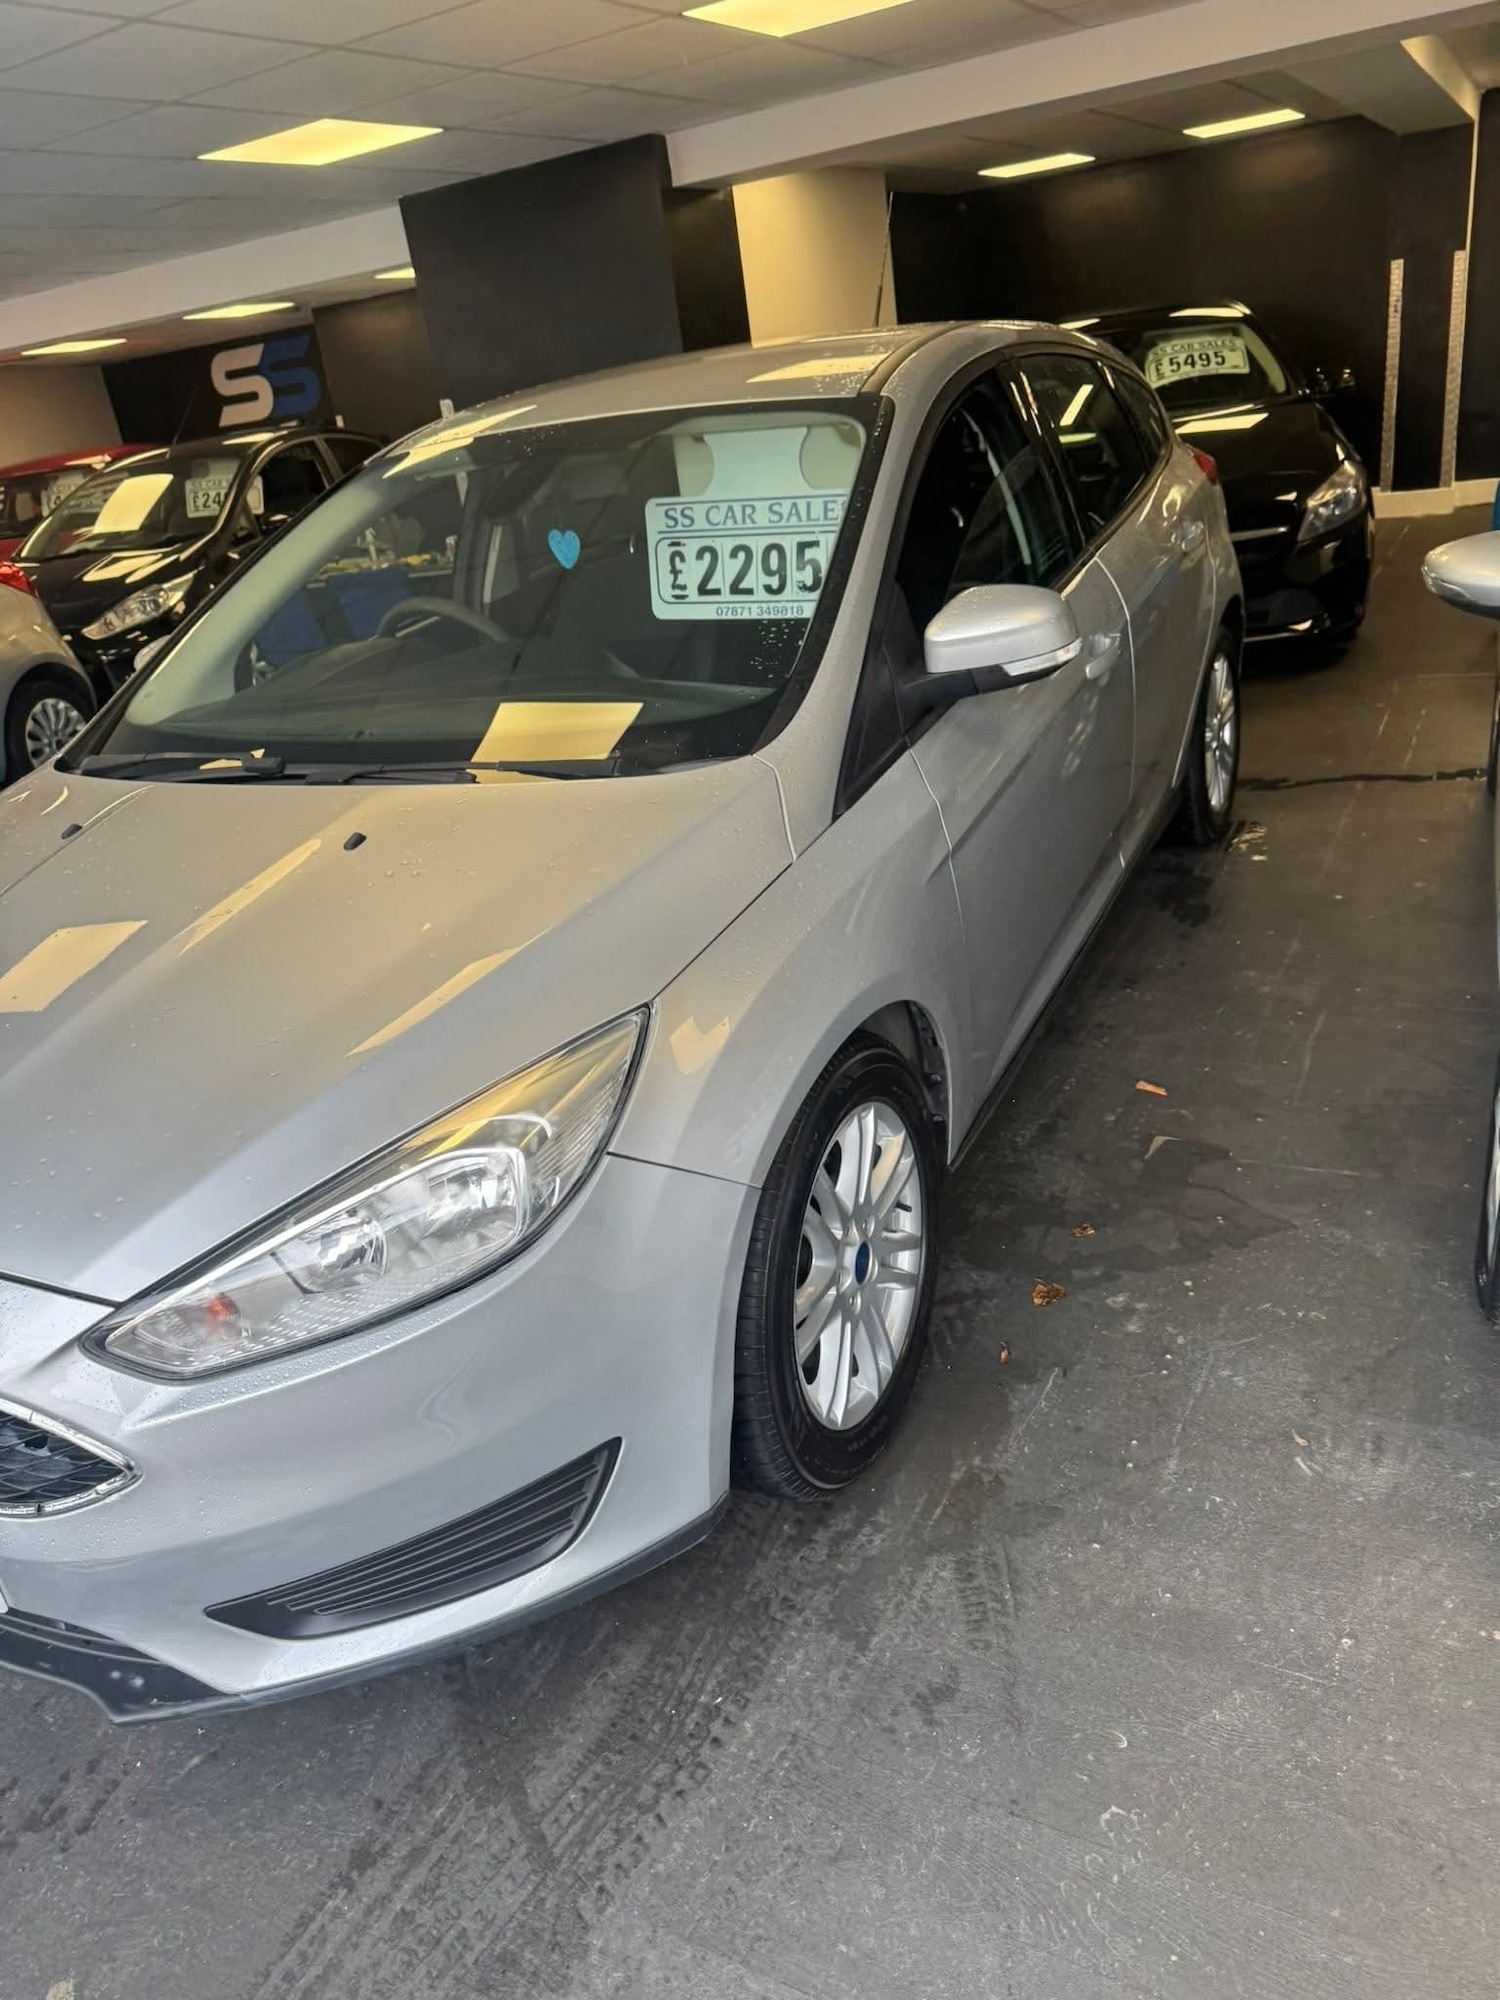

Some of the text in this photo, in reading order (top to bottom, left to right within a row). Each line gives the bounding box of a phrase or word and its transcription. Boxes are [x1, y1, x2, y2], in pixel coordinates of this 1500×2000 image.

[1171, 343, 1194, 354] CAR
[1200, 339, 1236, 350] SALES
[1155, 350, 1226, 377] £5495
[211, 336, 321, 427] SS
[664, 506, 695, 529] SS
[705, 504, 757, 526] CAR
[668, 540, 823, 599] £2295
[715, 605, 804, 617] 07871 349818
